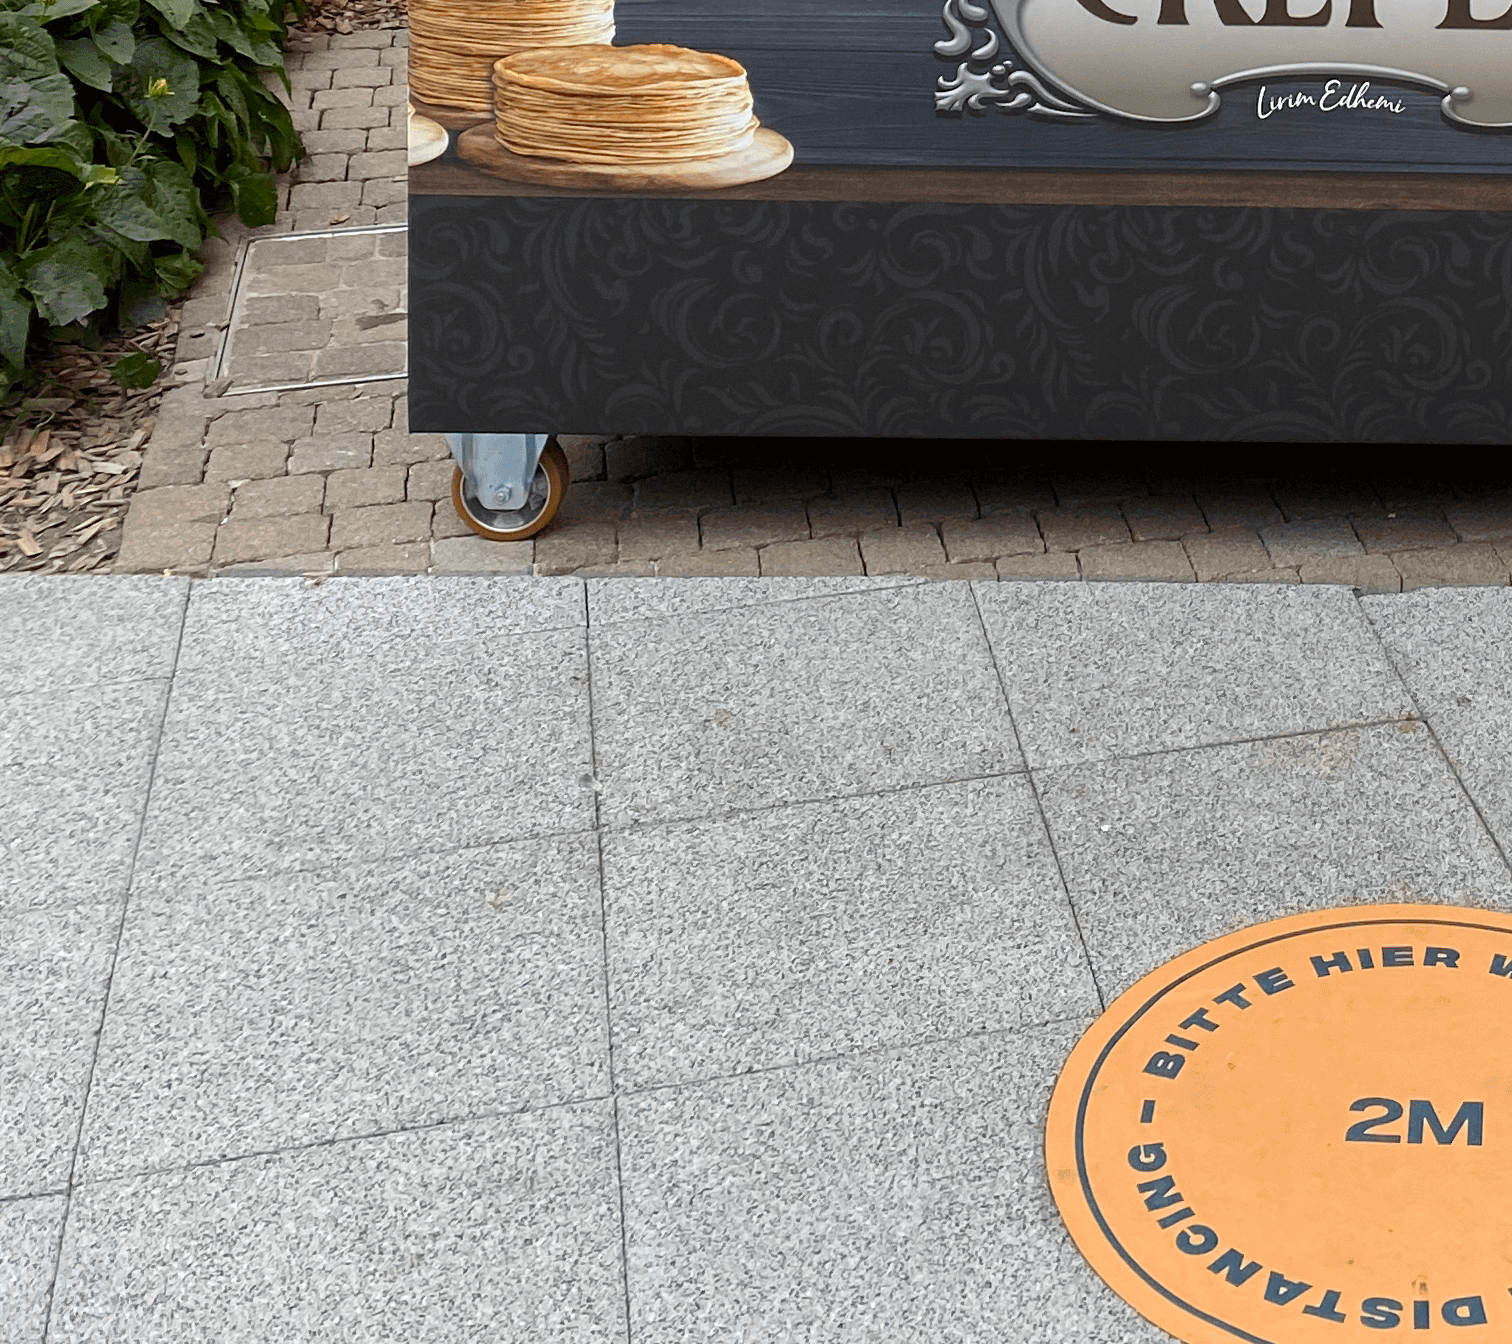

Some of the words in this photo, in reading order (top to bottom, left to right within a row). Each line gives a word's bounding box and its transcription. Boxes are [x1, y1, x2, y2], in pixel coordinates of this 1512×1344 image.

[1309, 945, 1460, 979] HIER
[1143, 967, 1295, 1081] BITTE
[1344, 1096, 1485, 1147] 2M
[1127, 1142, 1488, 1331] DISTANCING
